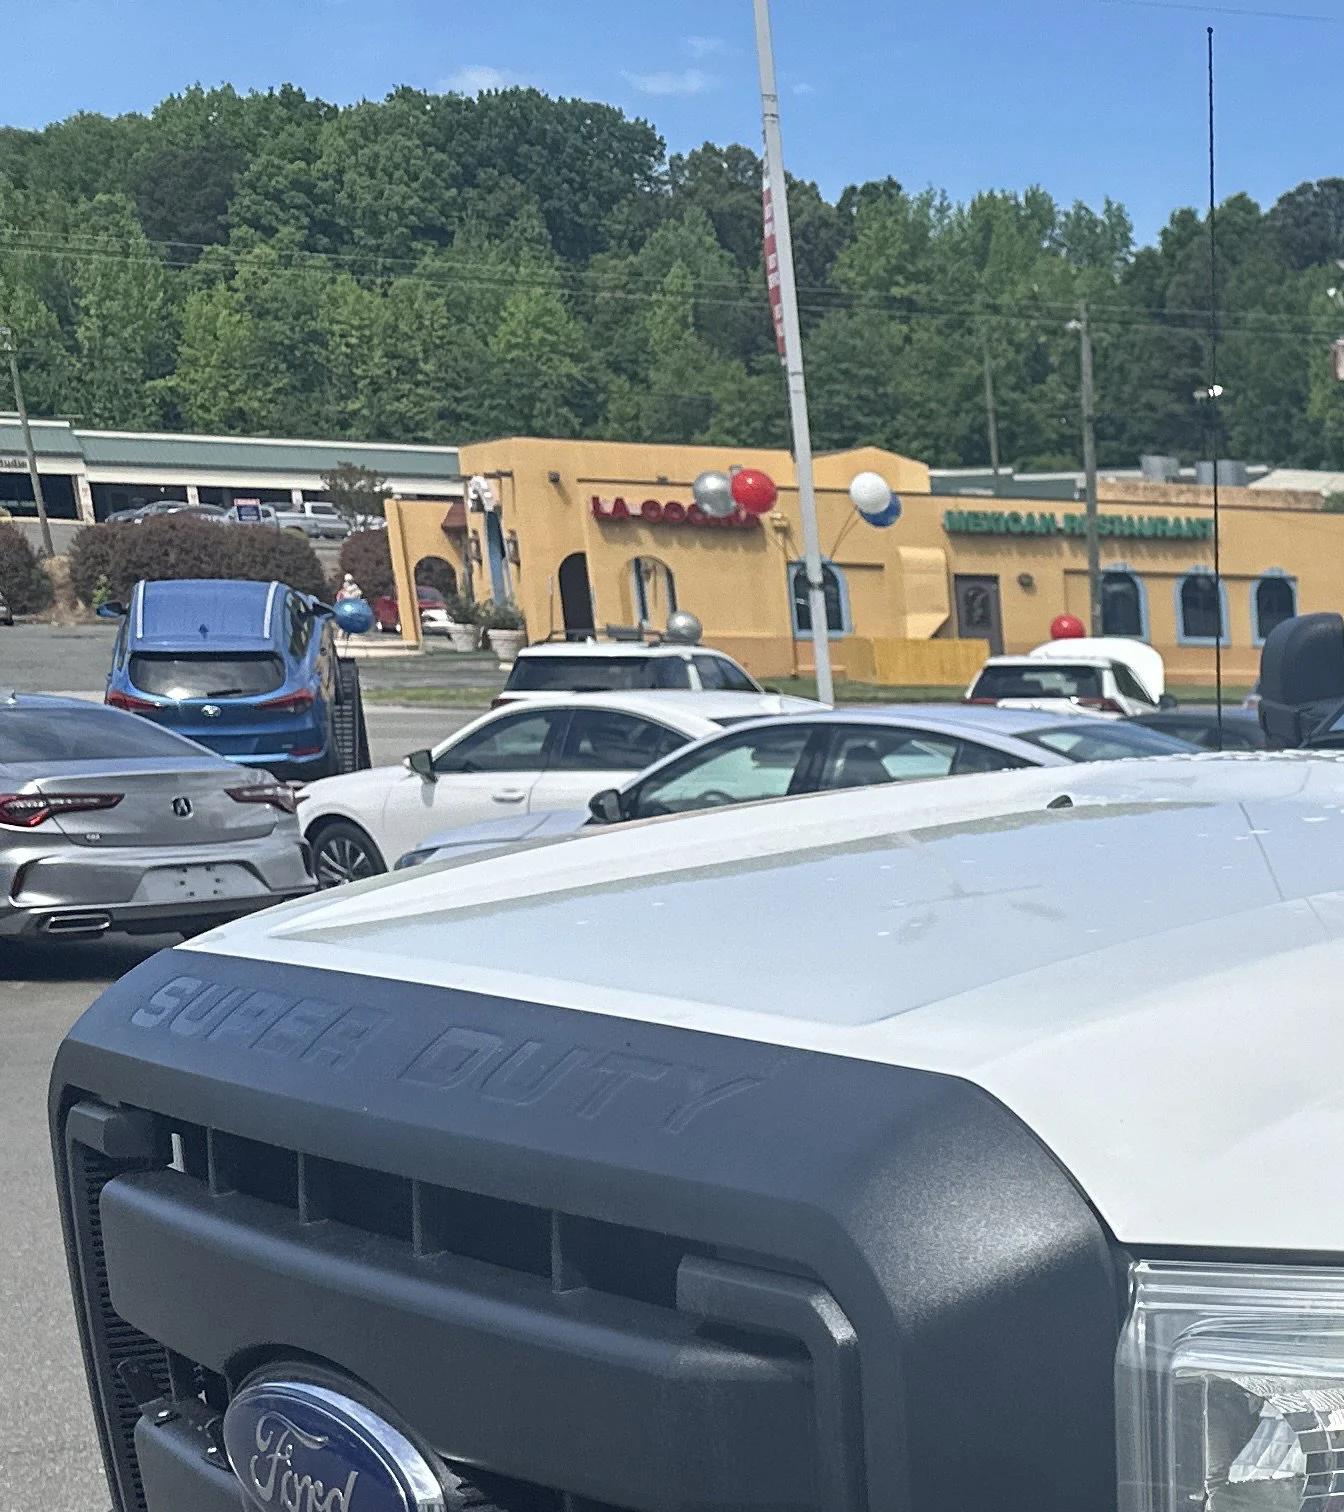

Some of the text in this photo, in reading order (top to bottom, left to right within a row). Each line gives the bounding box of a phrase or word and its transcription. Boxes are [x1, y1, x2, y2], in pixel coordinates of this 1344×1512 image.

[592, 496, 630, 518] LA
[942, 510, 1056, 534] MEXICAN
[130, 975, 765, 1135] SUPER DUTY
